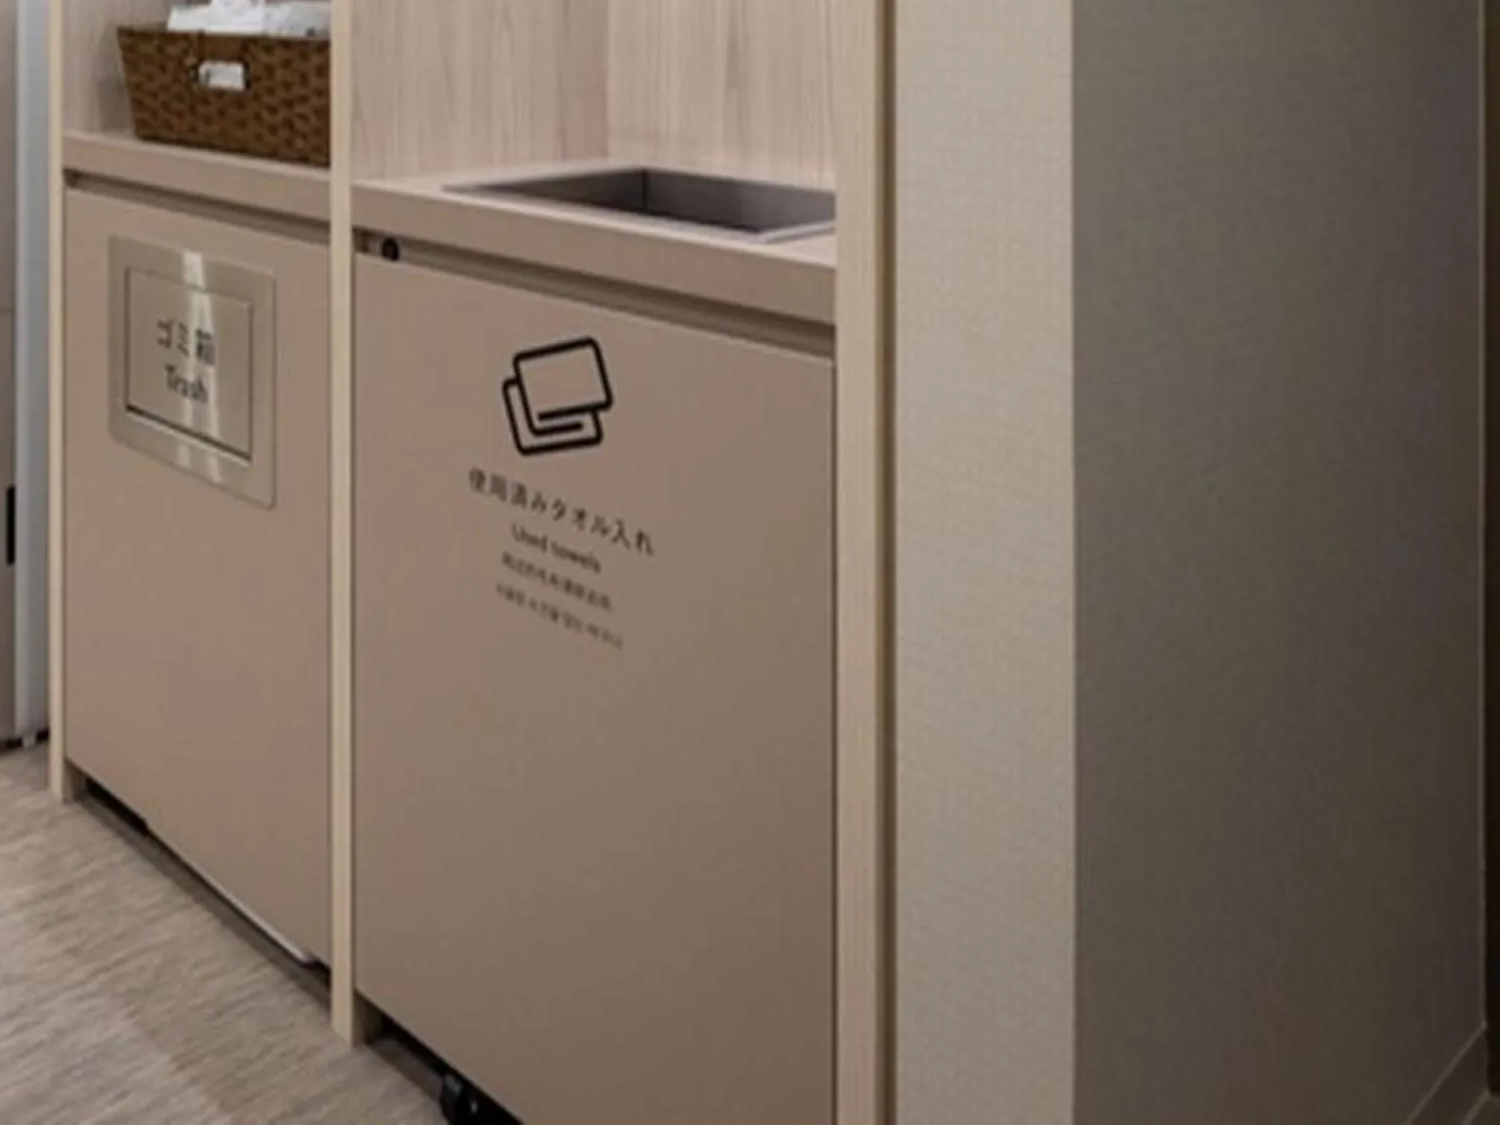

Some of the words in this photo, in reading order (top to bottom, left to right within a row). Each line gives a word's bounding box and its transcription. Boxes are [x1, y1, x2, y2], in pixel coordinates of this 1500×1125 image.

[164, 363, 209, 403] Trash
[469, 467, 655, 556] 使用済みタオル入れ
[511, 523, 548, 554] Used
